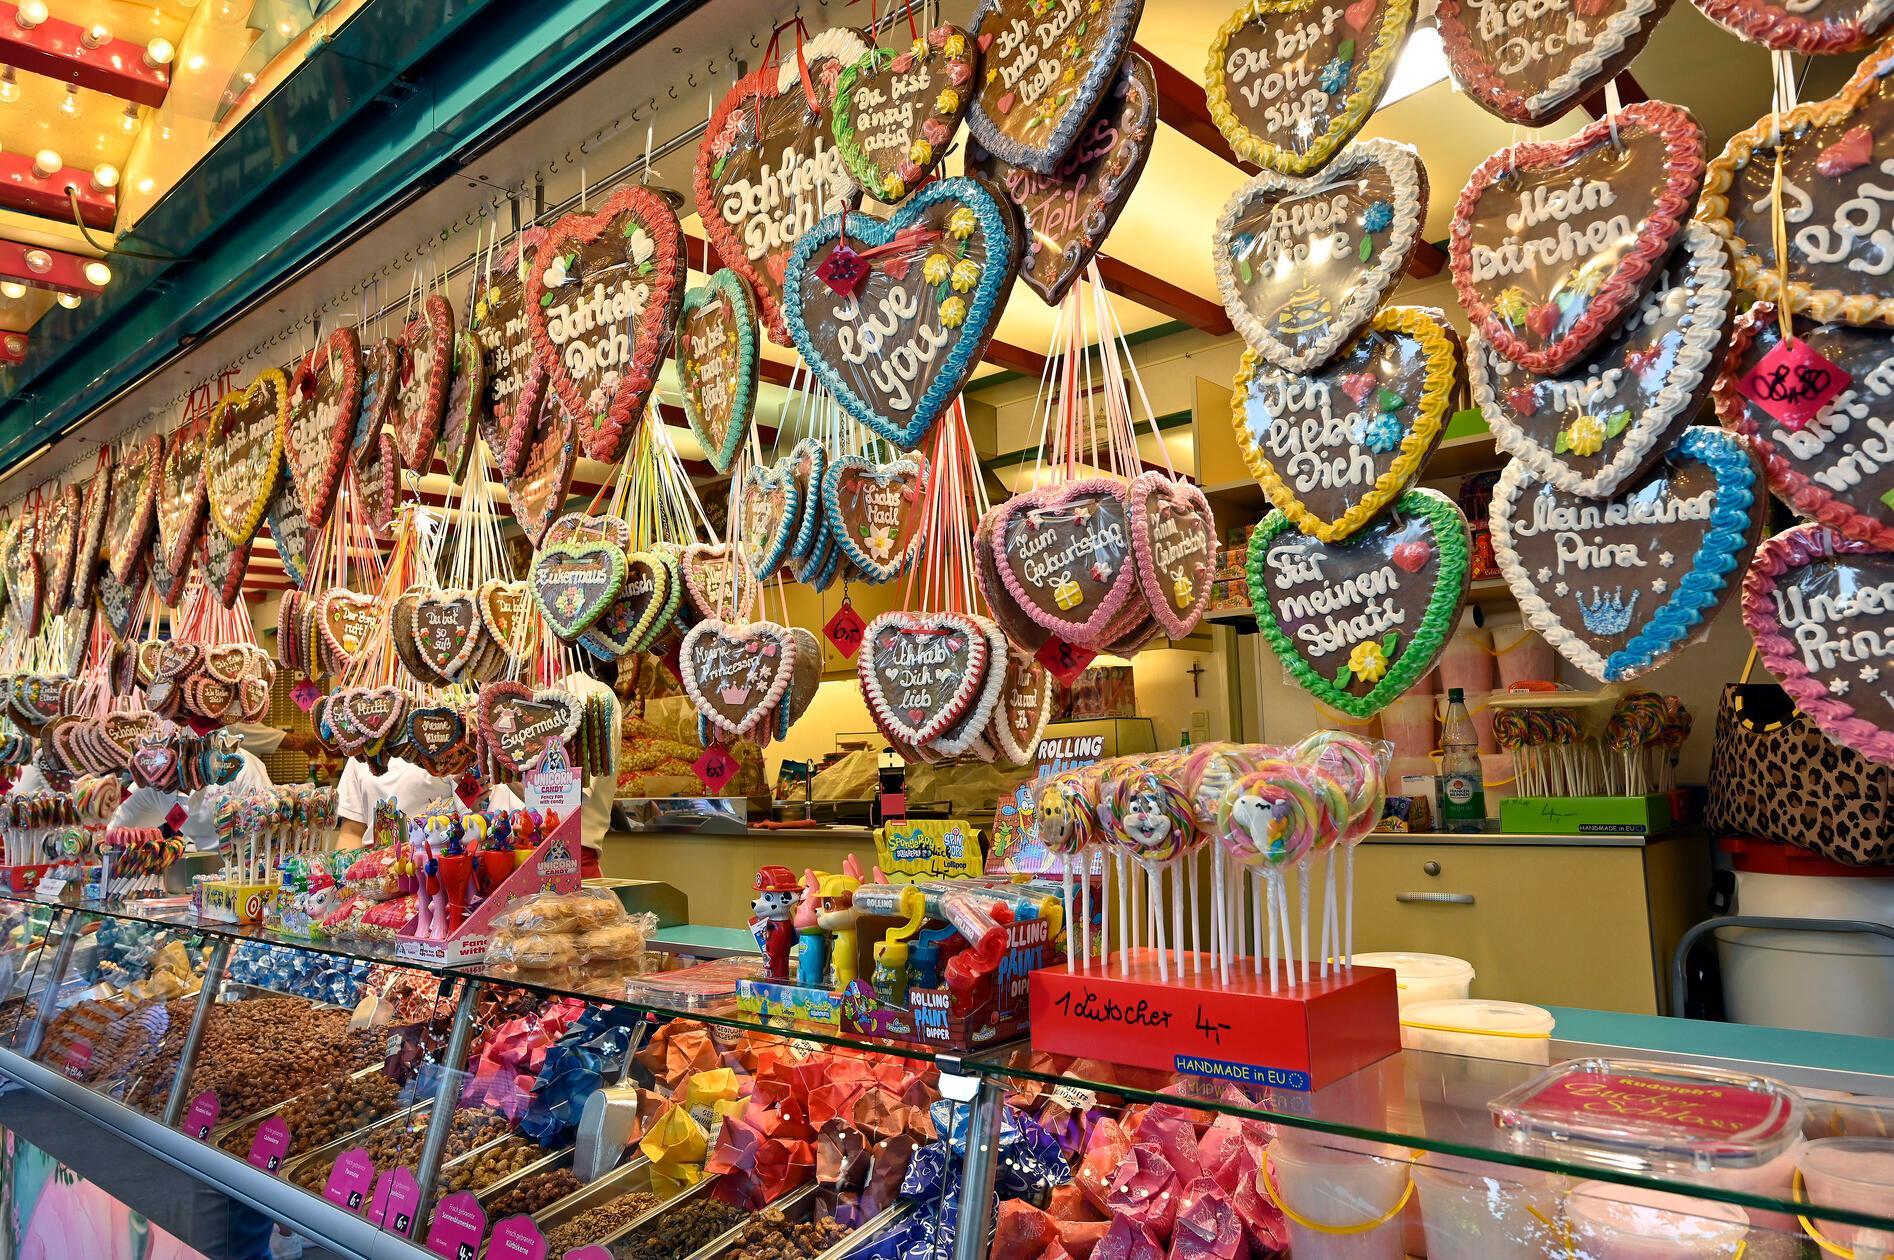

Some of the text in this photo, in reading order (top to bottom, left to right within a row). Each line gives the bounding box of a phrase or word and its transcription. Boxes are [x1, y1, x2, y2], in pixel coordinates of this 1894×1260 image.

[996, 18, 1030, 58] Ich
[1227, 6, 1345, 84] Du bist
[1496, 13, 1594, 75] Dich
[998, 42, 1039, 88] hab
[1018, 57, 1062, 107] lieb
[1240, 58, 1315, 108] voll
[854, 64, 931, 111] Du bist
[864, 127, 912, 153] artig
[723, 165, 779, 224] Ich
[1029, 174, 1088, 240] Teil
[1507, 176, 1617, 230] Mein
[745, 195, 814, 260] Dich
[1270, 195, 1348, 241] Alles
[1260, 231, 1352, 277] Liee
[1472, 215, 1634, 283] Bärchen
[547, 297, 595, 344] Ich
[565, 325, 631, 380] Dich
[871, 325, 947, 410] you
[1261, 373, 1332, 419] Ich
[1266, 407, 1362, 459] liebe
[1287, 446, 1376, 493] Dich
[1150, 512, 1179, 541] Zum
[1515, 490, 1603, 537] Mein
[1016, 528, 1057, 560] Zum
[1023, 522, 1127, 588] Geburtstag
[1154, 528, 1208, 574] Geburtstag
[1554, 531, 1648, 575] Prinz
[1266, 545, 1328, 589] Für
[343, 608, 357, 621] Der
[1278, 566, 1400, 622] meinen
[426, 610, 459, 625] Du bist
[436, 628, 447, 639] so
[1297, 597, 1405, 657] Schatz
[433, 638, 452, 652] süß
[700, 655, 760, 679] Prinzessin
[898, 688, 932, 709] lieb
[899, 666, 934, 689] Dich
[1038, 736, 1101, 759] ROLLING
[534, 771, 573, 786] UNICORN
[541, 785, 564, 793] CANDY
[944, 833, 963, 847] SPIN
[537, 860, 577, 871] UNICORN
[943, 860, 967, 870] Lollipop
[866, 898, 893, 909] ROLLING
[1006, 921, 1047, 949] OLLING
[911, 991, 950, 1009] ROLLING
[914, 1007, 949, 1029] PAINT
[1055, 992, 1071, 1016] 1
[926, 1026, 950, 1041] DIPPER
[1176, 1056, 1287, 1085] HANDMADE in EU
[1618, 1077, 1723, 1098] Rudolph's
